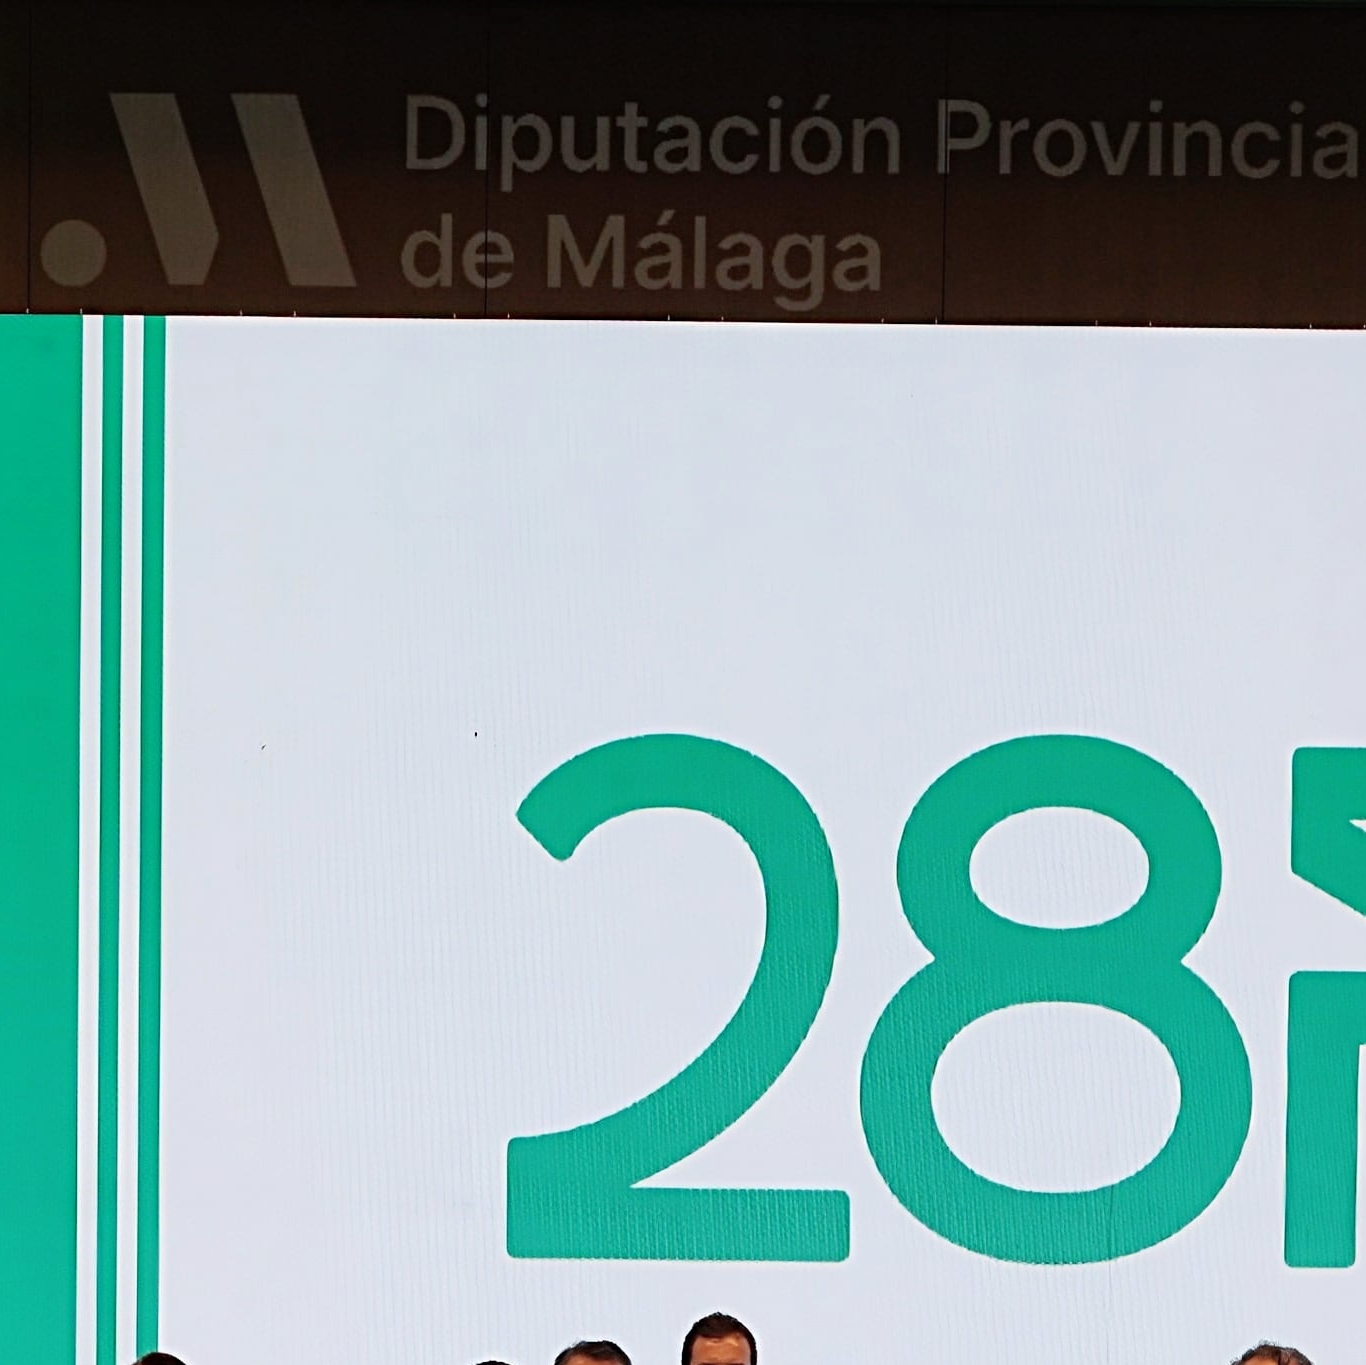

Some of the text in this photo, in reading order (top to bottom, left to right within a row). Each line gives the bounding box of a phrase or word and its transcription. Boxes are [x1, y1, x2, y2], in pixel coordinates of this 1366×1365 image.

[405, 94, 901, 193] Diputación
[401, 209, 882, 311] de Málaga
